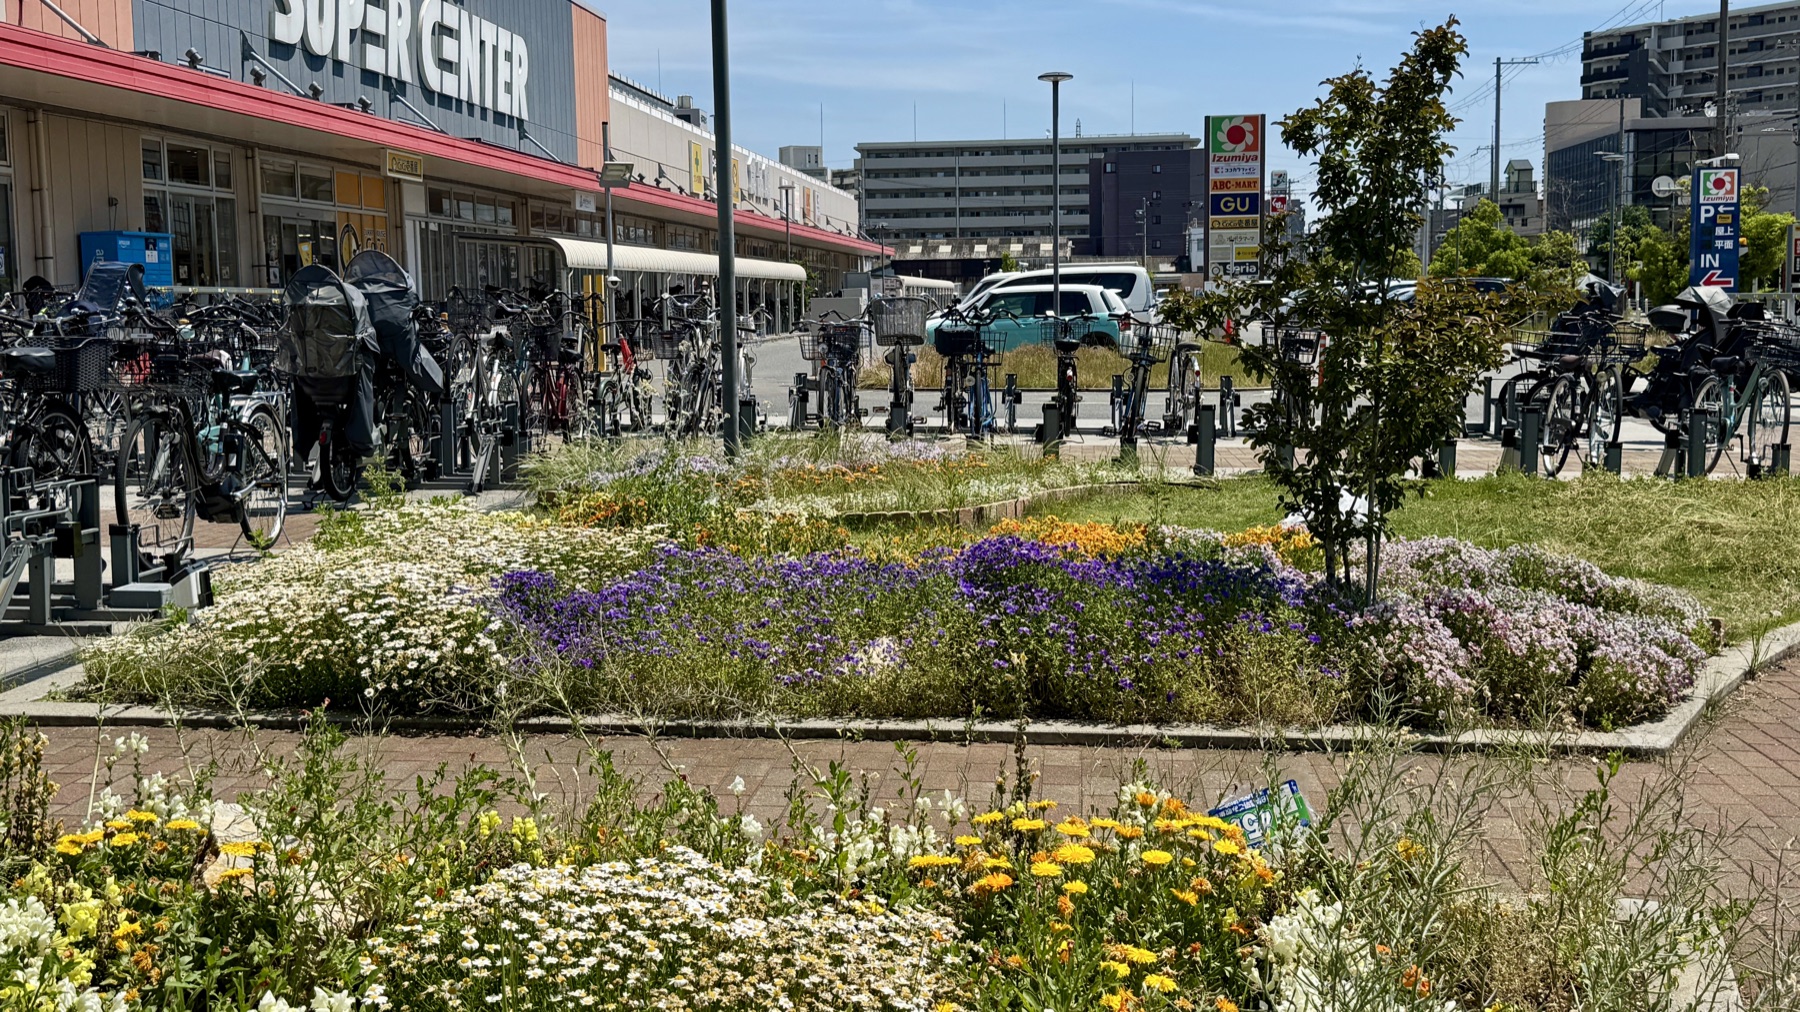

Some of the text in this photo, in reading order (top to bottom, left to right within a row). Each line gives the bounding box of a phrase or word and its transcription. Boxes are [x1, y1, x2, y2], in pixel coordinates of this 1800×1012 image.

[419, 0, 529, 121] CENTER
[1212, 154, 1258, 163] Izumiya
[1212, 181, 1257, 190] ABC-MART
[1220, 197, 1249, 212] GU
[1700, 205, 1715, 224] P
[1715, 227, 1733, 236] 屋上
[1714, 240, 1733, 249] 平面
[1700, 254, 1719, 268] IN
